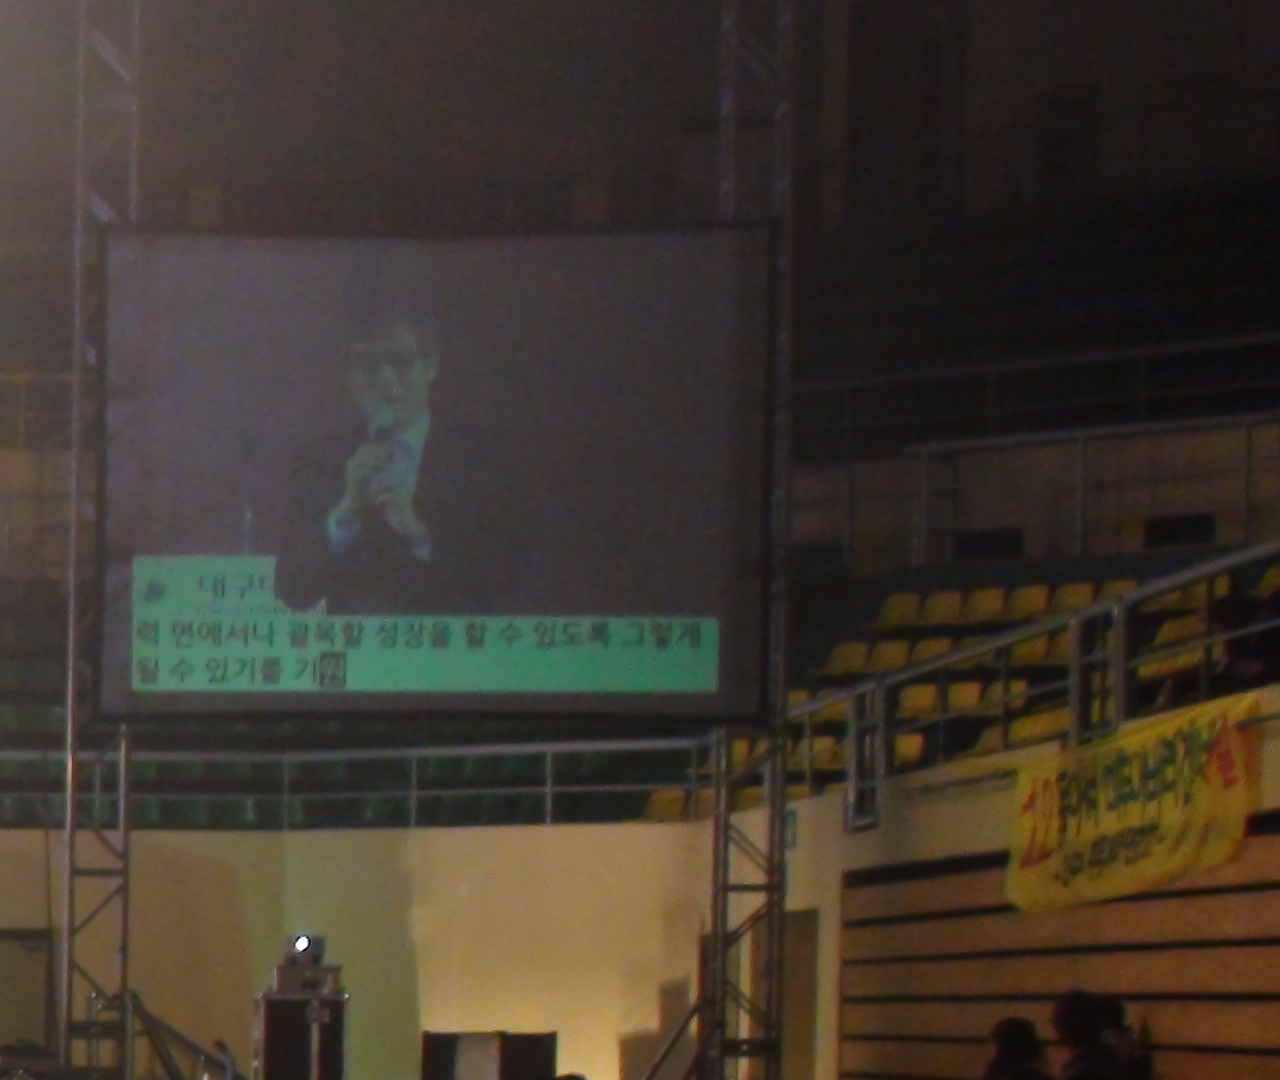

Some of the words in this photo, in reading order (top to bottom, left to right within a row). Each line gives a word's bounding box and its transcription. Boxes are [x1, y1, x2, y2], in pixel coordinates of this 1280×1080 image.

[498, 621, 522, 648] 수
[534, 619, 608, 649] 있도록
[620, 619, 701, 649] 그렇게
[169, 658, 195, 684] 수
